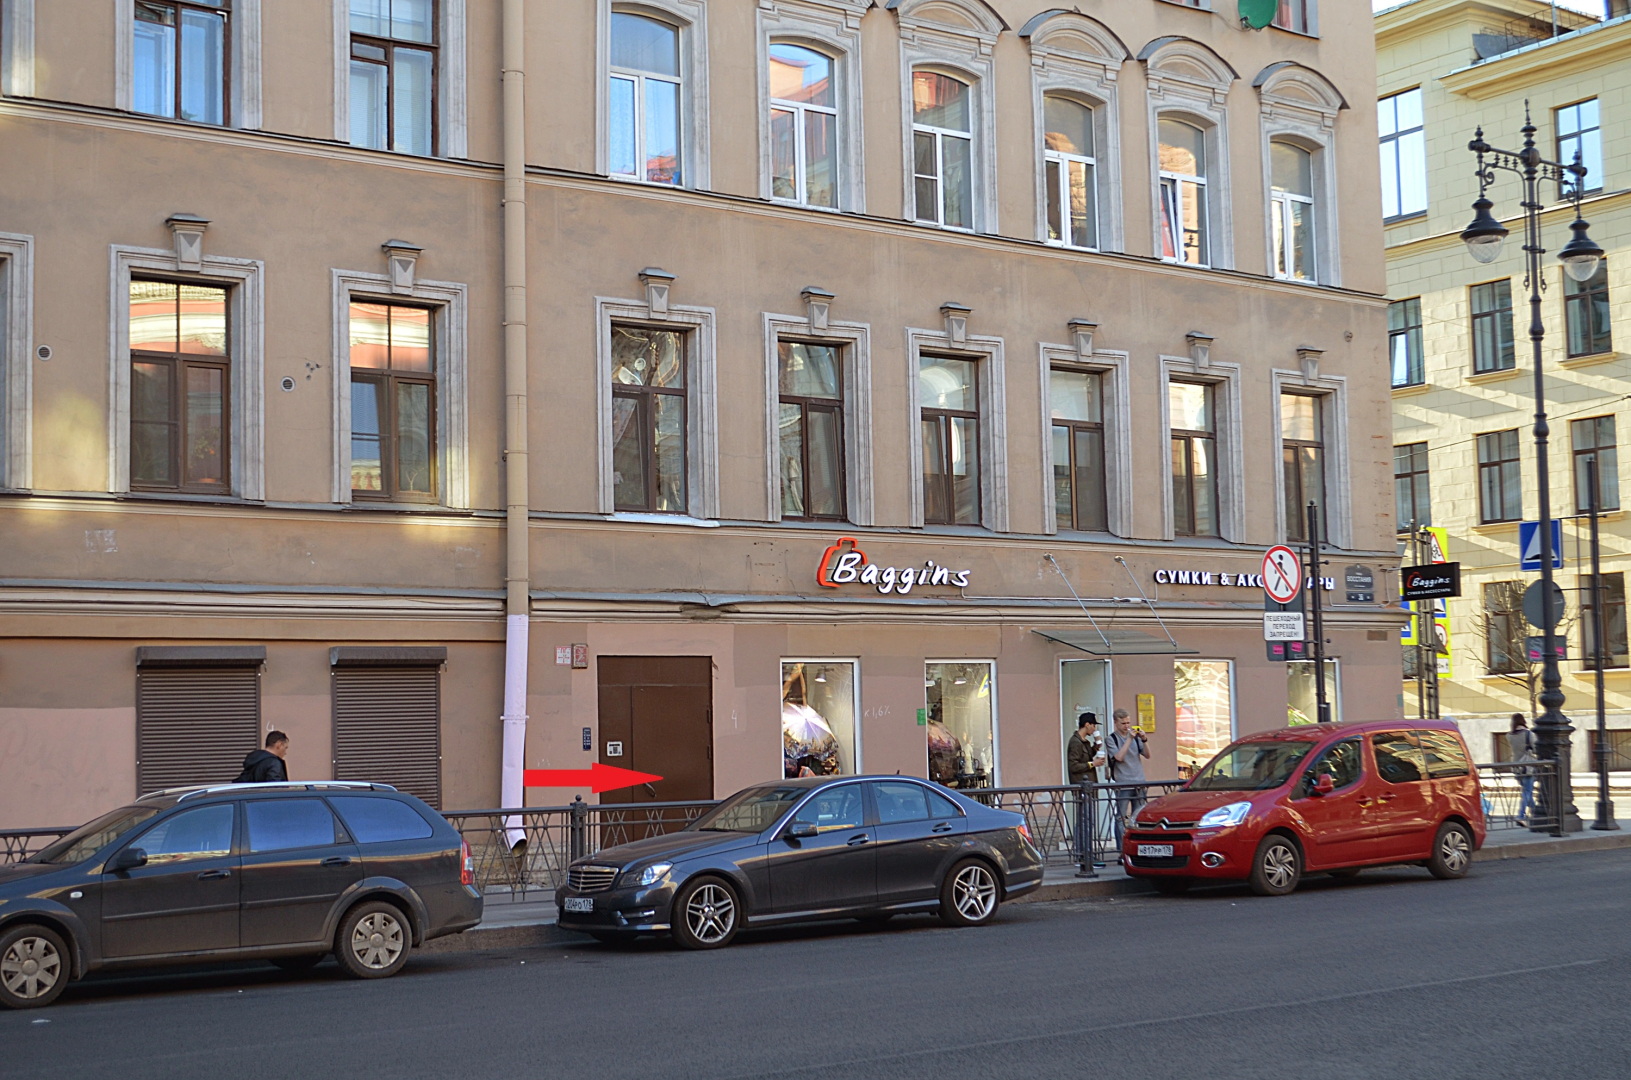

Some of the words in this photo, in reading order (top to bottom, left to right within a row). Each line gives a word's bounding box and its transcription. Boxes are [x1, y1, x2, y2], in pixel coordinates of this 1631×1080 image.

[832, 552, 971, 594] Baggins
[1155, 569, 1211, 585] СУМКИ
[1219, 572, 1230, 586] &
[1412, 576, 1451, 588] Baggins
[1266, 614, 1301, 622] ПЕШЕХОДНЫЙ
